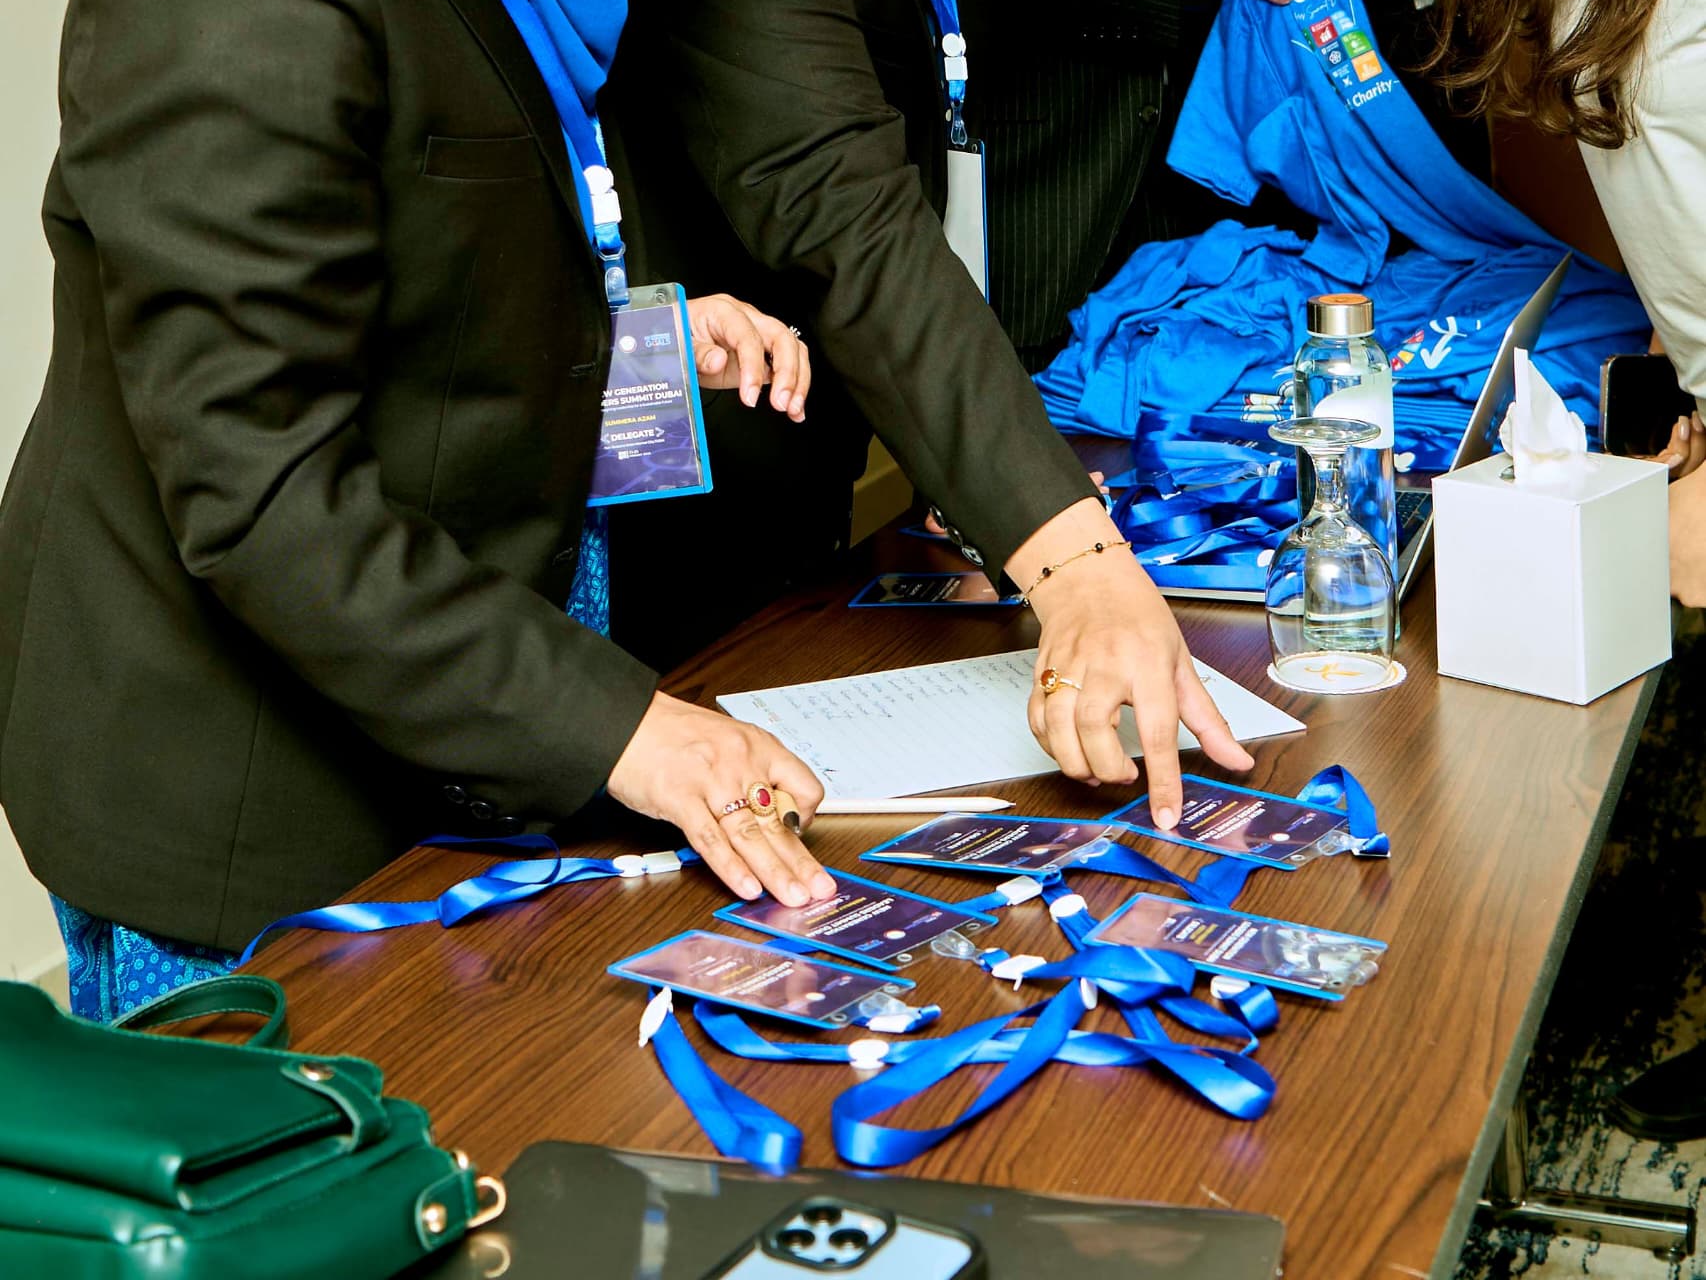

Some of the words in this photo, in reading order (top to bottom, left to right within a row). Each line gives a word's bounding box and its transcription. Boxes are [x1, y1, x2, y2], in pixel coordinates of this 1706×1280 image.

[1352, 79, 1392, 107] Charity
[614, 382, 668, 395] GENERATION
[621, 394, 653, 404] SUMMIT
[655, 389, 682, 400] DUBAI
[611, 429, 655, 441] DELEGATE
